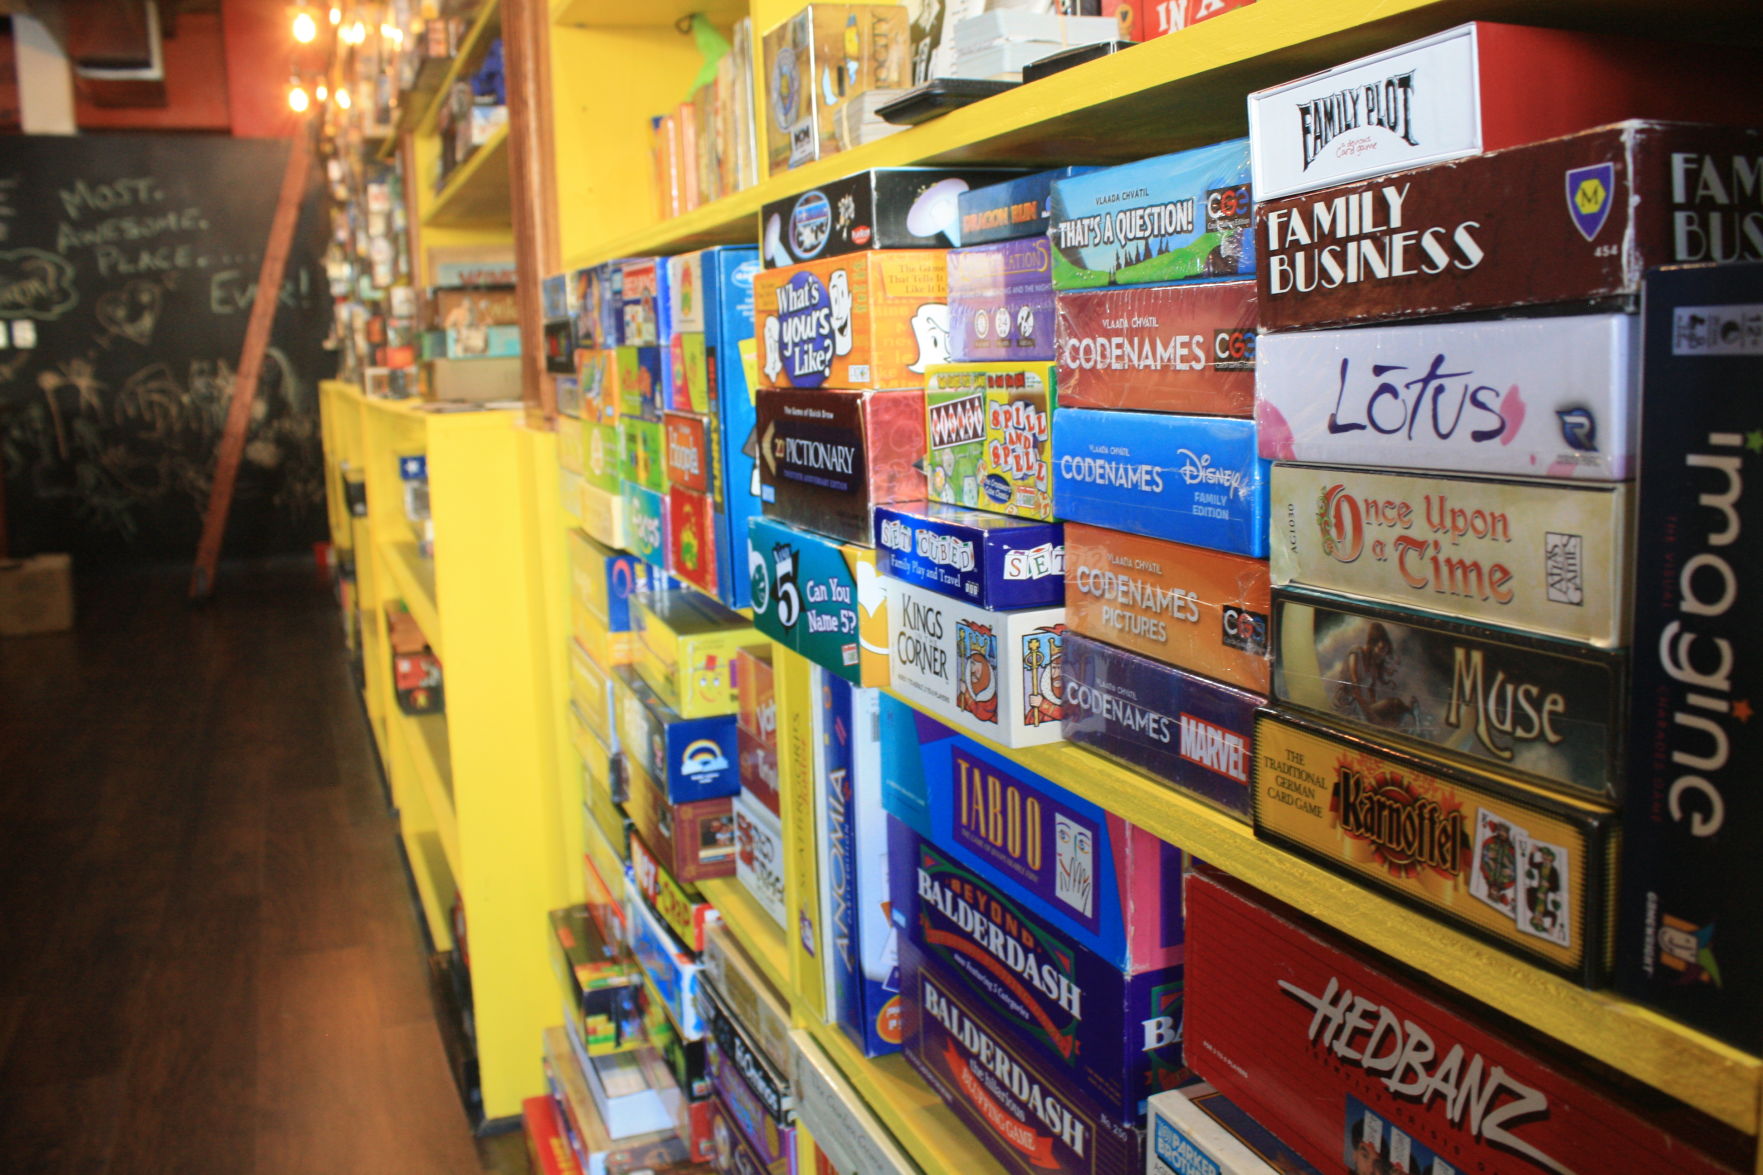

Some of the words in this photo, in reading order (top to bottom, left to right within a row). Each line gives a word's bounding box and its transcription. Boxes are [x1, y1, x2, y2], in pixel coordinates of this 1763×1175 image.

[1296, 87, 1360, 172] FAMILY
[1363, 69, 1419, 146] PLOT
[1096, 193, 1120, 206] VLAADA
[1268, 183, 1410, 251] FAMILY
[1058, 217, 1102, 249] THAT'S
[1103, 215, 1115, 242] A
[1116, 199, 1194, 247] QUESTION!
[1270, 221, 1485, 294] BUSINESS
[1594, 244, 1618, 257] 454
[776, 275, 820, 315] What's
[783, 306, 830, 357] yours
[1065, 334, 1206, 370] CODENAMES
[794, 338, 833, 377] Like?
[991, 406, 1047, 435] SPILL
[1008, 430, 1033, 450] AND
[785, 437, 855, 474] PICTIONARY
[992, 443, 1046, 483] SPELL
[1060, 455, 1164, 493] CODENAMES
[1192, 504, 1230, 520] EDITION
[1194, 491, 1227, 506] FAMILY
[1318, 484, 1414, 563] Once
[1424, 494, 1512, 546] Upon
[882, 521, 911, 551] SET
[918, 535, 973, 572] CUBED
[776, 557, 800, 627] 5
[807, 580, 828, 603] Can
[829, 577, 851, 604] You
[890, 553, 910, 576] Family
[911, 560, 926, 580] Play
[926, 566, 938, 581] and
[939, 569, 961, 589] Travel
[1372, 540, 1388, 562] a
[1394, 535, 1514, 605] Time
[902, 592, 944, 641] KINGS
[1077, 566, 1200, 623] CODENAMES
[807, 608, 838, 634] Name
[840, 609, 857, 635] 5?
[1103, 605, 1168, 643] PICTURES
[1658, 431, 1744, 837] imagine
[898, 630, 949, 681] CORNER
[1067, 682, 1171, 743] CODENAMES
[1181, 716, 1247, 781] MARVEL
[1286, 749, 1304, 766] THE
[1264, 755, 1328, 790] TRADITIONAL
[1275, 775, 1316, 801] GERMAN
[957, 758, 1041, 871] TABOO
[1267, 786, 1295, 807] CARD
[1294, 799, 1324, 819] GAME
[829, 768, 853, 973] ANOMIA
[950, 877, 1034, 950] BEYOND
[917, 868, 1082, 1020] BALDERDASH
[925, 981, 1084, 1158] BALDERDASH
[1278, 977, 1578, 1175] HEDBANZ
[1005, 1119, 1036, 1151] GAME
